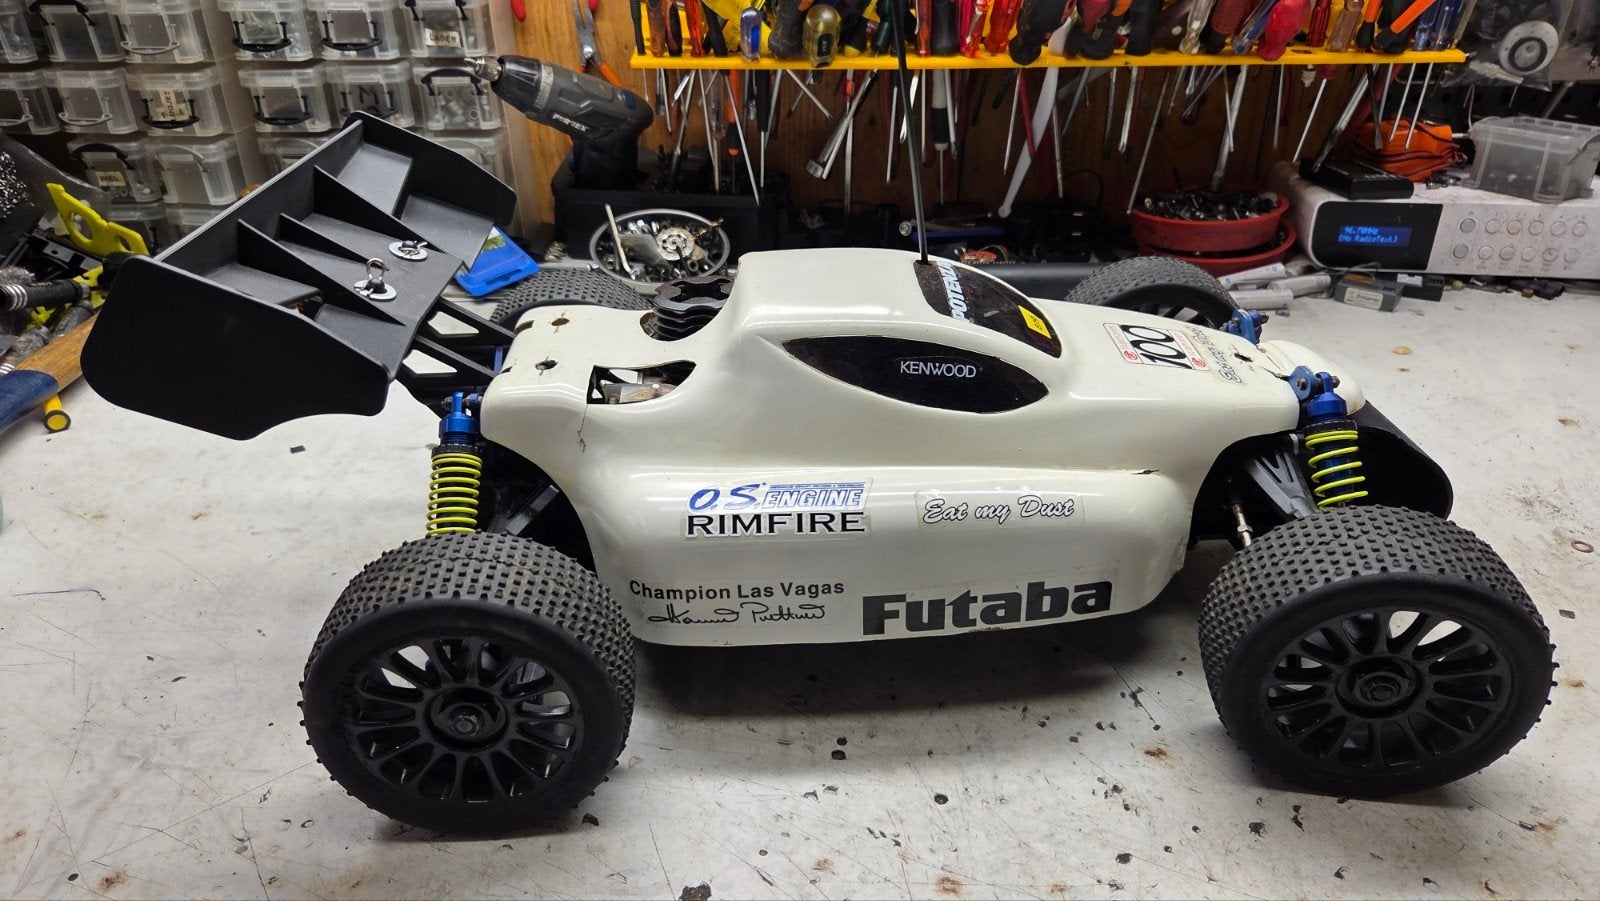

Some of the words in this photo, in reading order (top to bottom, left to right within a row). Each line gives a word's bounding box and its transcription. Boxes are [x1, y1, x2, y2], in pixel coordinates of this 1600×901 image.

[936, 260, 968, 321] POTENZ
[1119, 324, 1193, 370] 100
[900, 361, 977, 378] KENWOOD
[761, 488, 864, 509] ENGINE
[923, 498, 968, 524] Eat
[975, 504, 1011, 524] my
[1018, 495, 1074, 518] Dust
[687, 511, 866, 535] RIMFIRE
[629, 579, 730, 603] Champion
[737, 584, 774, 599] Las
[780, 582, 845, 598] Vagas
[863, 580, 1113, 636] Futaba
